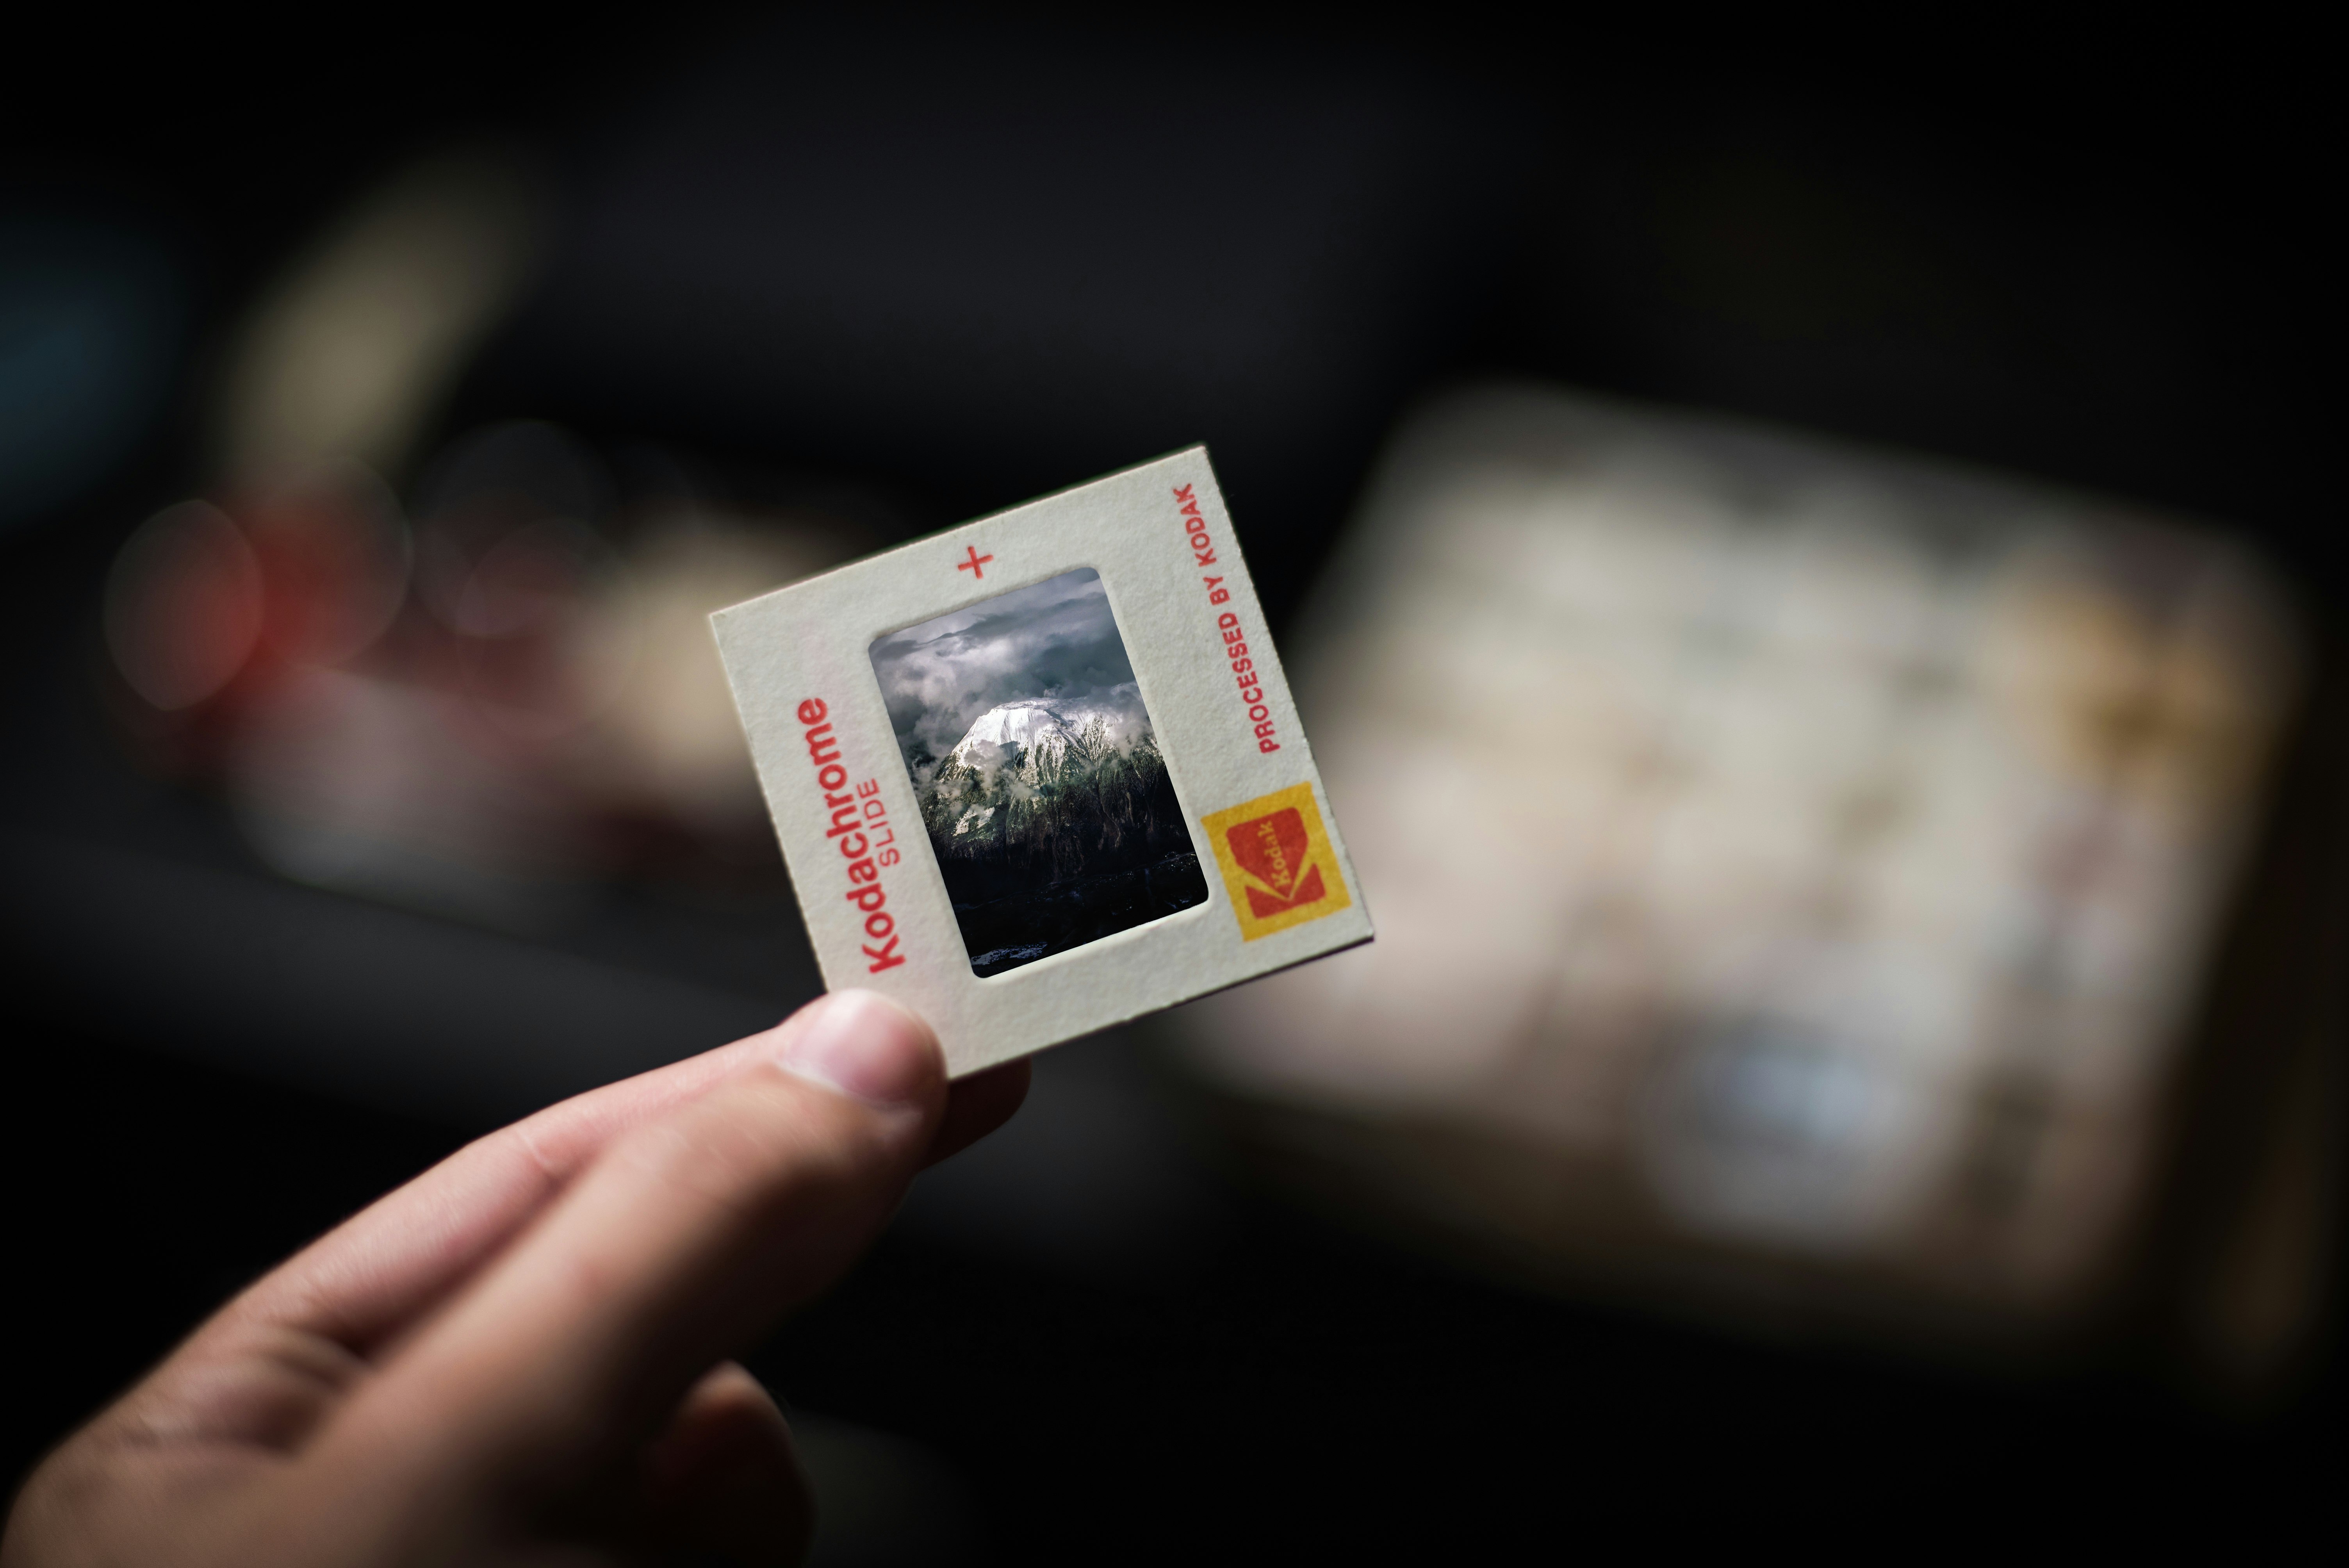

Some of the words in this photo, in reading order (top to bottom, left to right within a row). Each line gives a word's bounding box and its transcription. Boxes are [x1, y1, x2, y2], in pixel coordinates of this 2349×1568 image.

[1173, 484, 1217, 567] KODAK
[1203, 576, 1230, 605] BY
[1217, 613, 1281, 754] PROCESSED
[797, 698, 906, 975] Kodachrome
[856, 779, 900, 867] SLIDE
[1257, 821, 1291, 888] Kodak
